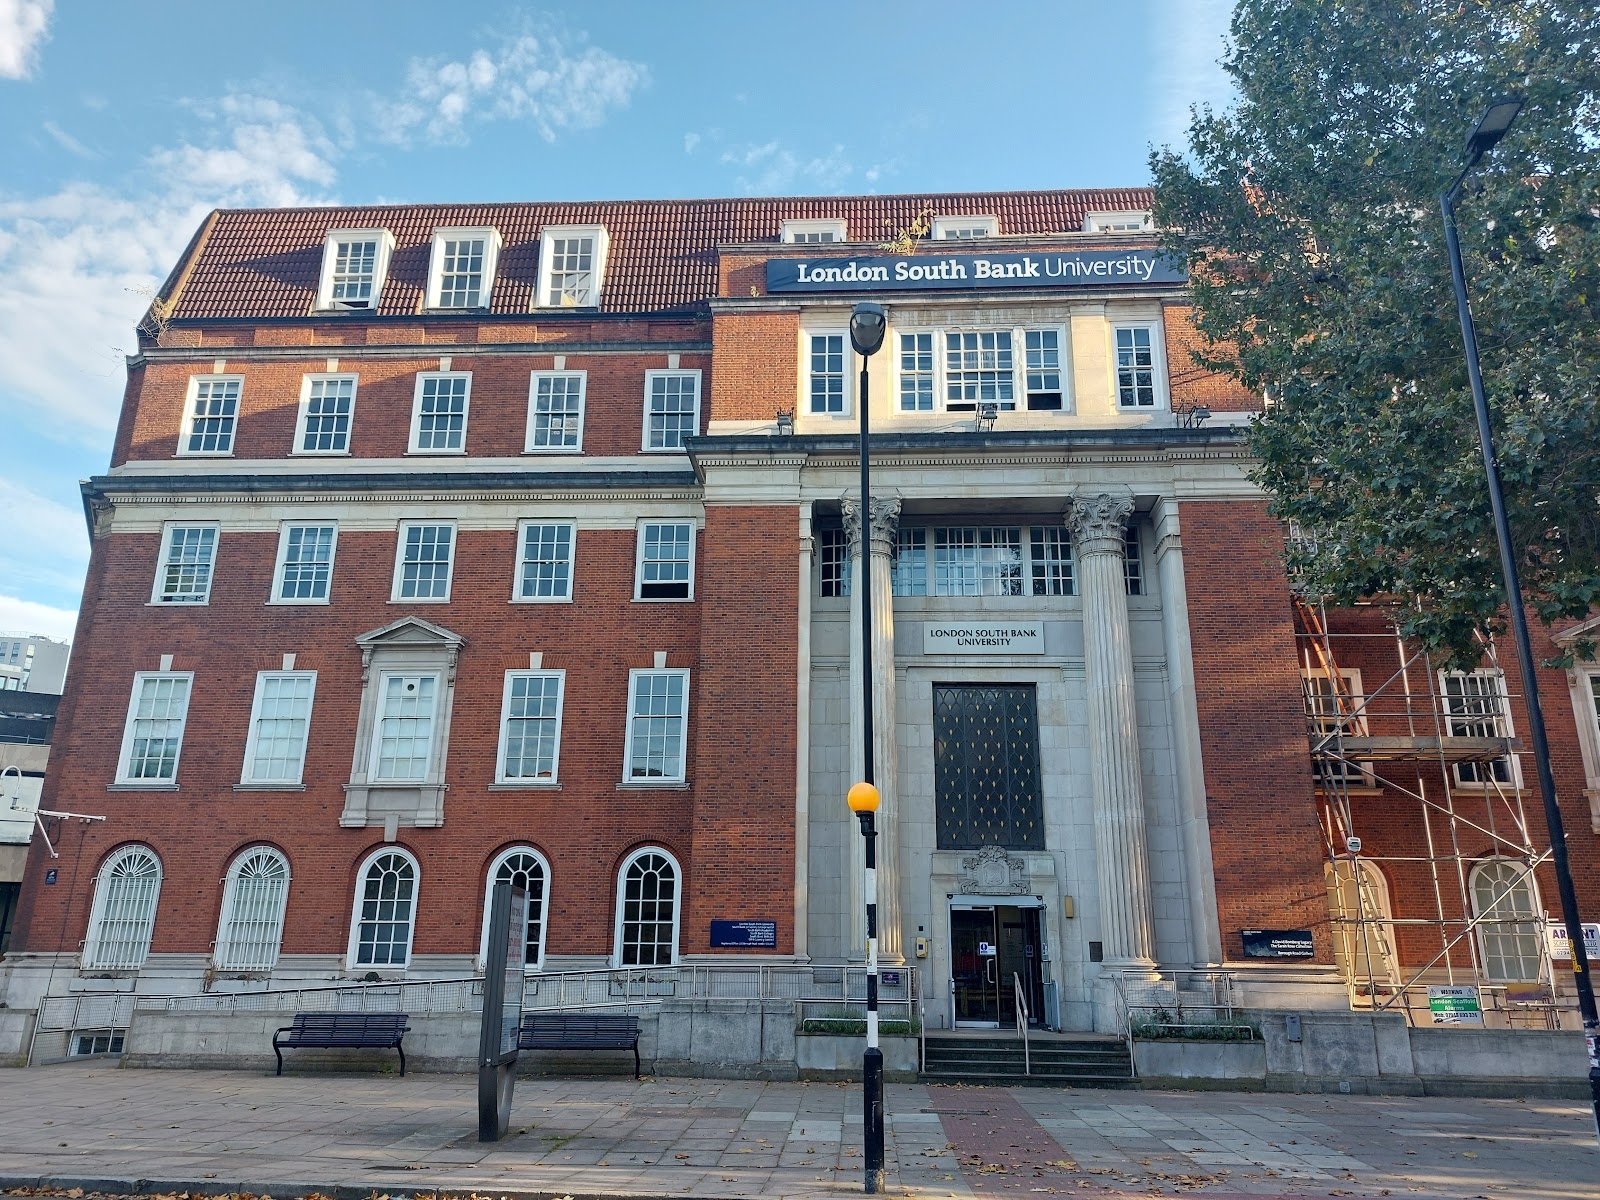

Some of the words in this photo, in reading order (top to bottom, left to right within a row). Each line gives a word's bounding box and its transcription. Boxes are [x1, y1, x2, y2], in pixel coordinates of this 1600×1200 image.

[797, 262, 889, 283] London
[895, 259, 967, 281] South
[974, 257, 1040, 279] Bank
[1045, 255, 1156, 281] University
[930, 629, 973, 637] LONDON
[975, 629, 1008, 637] SOUTH
[1011, 629, 1037, 637] BANK
[957, 638, 1011, 646] UNIVERSITY
